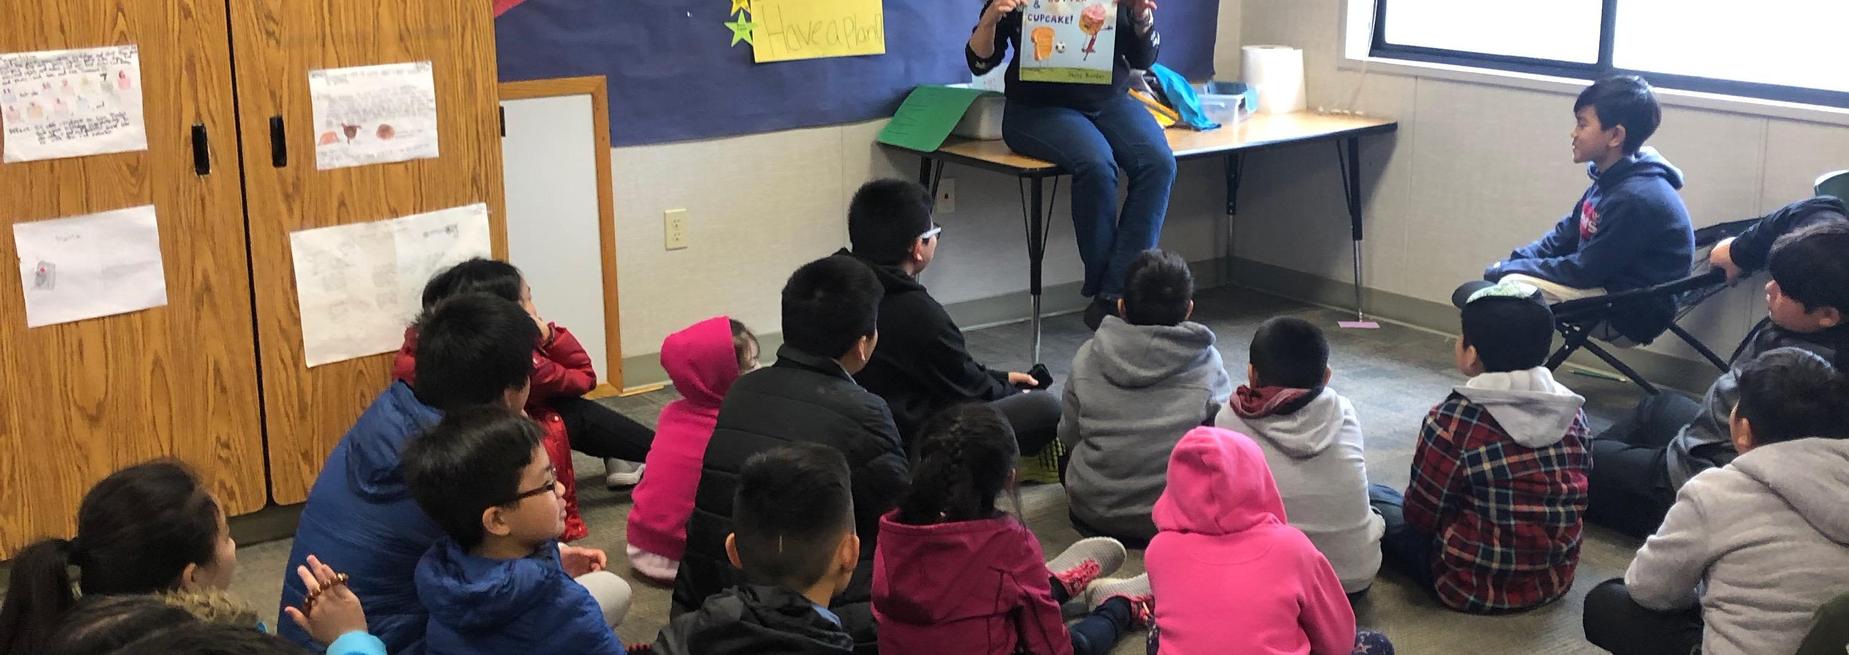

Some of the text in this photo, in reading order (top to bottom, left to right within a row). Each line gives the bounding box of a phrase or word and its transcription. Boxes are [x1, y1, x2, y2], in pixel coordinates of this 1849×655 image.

[761, 4, 823, 57] Have
[826, 18, 841, 46] a
[1027, 13, 1074, 25] CUPCAKE!
